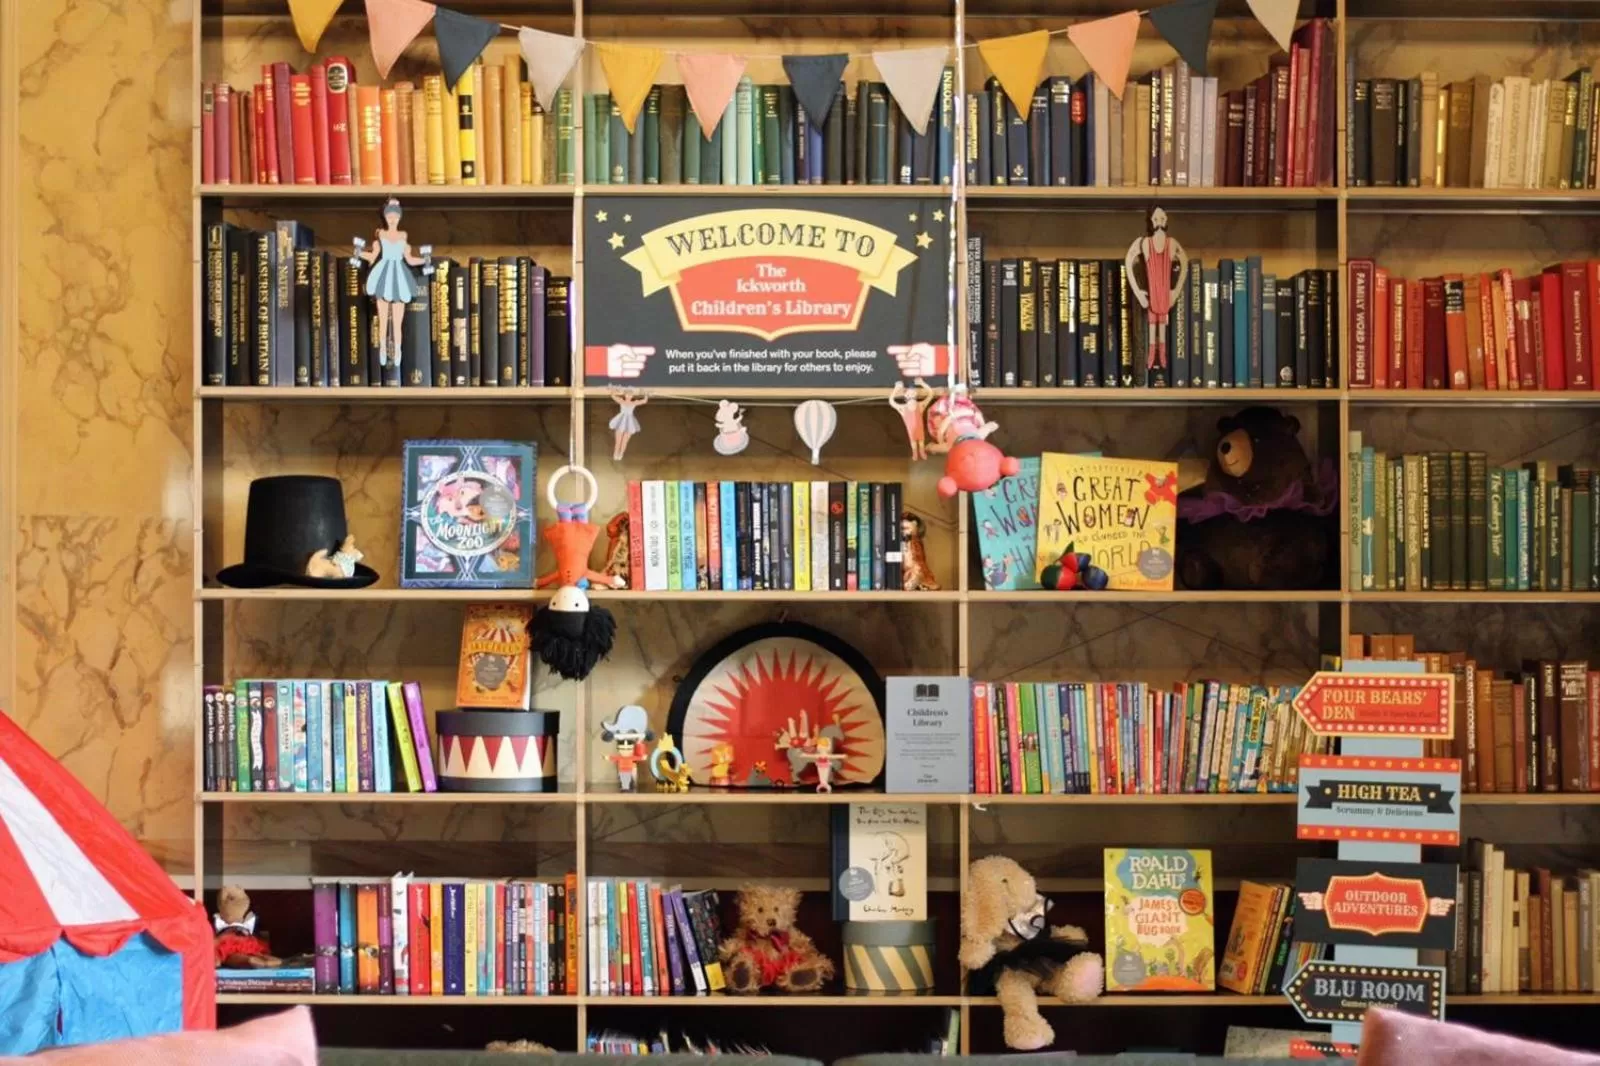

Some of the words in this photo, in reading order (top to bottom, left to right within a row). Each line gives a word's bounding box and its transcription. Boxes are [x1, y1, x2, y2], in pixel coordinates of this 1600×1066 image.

[665, 222, 826, 258] WELCOME
[834, 228, 876, 258] TO
[258, 235, 269, 303] TREASURES
[312, 256, 321, 287] POLE
[756, 262, 787, 278] The
[278, 265, 289, 308] NATURE
[736, 278, 806, 293] Ickworth
[1356, 273, 1365, 309] FAMILY
[258, 306, 269, 322] OF
[312, 295, 321, 327] POLE
[691, 300, 781, 316] Children's
[785, 300, 852, 319] Library
[1356, 312, 1365, 343] WORD
[258, 324, 269, 370] BRITAIN
[665, 349, 694, 359] When
[695, 349, 727, 361] you've
[729, 348, 768, 359] finished
[770, 348, 790, 359] with
[791, 351, 814, 361] your
[815, 348, 842, 361] book,
[844, 348, 877, 361] please
[669, 363, 685, 375] put
[685, 362, 694, 372] it
[696, 362, 720, 372] back
[723, 362, 731, 372] in
[732, 362, 750, 372] the
[751, 362, 783, 375] library
[784, 362, 798, 372] for
[799, 362, 831, 372] others
[833, 363, 843, 372] to
[844, 363, 874, 375] enjoy.
[1356, 344, 1365, 381] FINDER
[1073, 475, 1140, 502] GREAT
[1491, 474, 1502, 491] The
[1056, 501, 1151, 535] WOMEN
[1351, 505, 1359, 514] in
[1408, 515, 1417, 524] of
[1351, 516, 1359, 546] colour
[456, 535, 484, 549] ZOO
[1466, 665, 1475, 706] COUNTRY
[1322, 688, 1366, 704] FOUR
[1370, 690, 1427, 706] BEARS'
[1322, 705, 1356, 721] DEN
[913, 719, 942, 728] Library
[1466, 707, 1475, 749] COOKING
[1337, 783, 1382, 800] HIGH
[1386, 786, 1422, 802] TEA
[1336, 806, 1374, 817] Scrummy
[1385, 807, 1424, 817] Delicious
[1128, 855, 1188, 873] ROALD
[1345, 890, 1407, 904] OUTDOOR
[1135, 912, 1181, 923] GIANT
[1333, 902, 1418, 917] ADVENTURES
[1137, 924, 1158, 936] BUG
[1314, 978, 1356, 998] BLU
[1361, 980, 1425, 1002] ROOM
